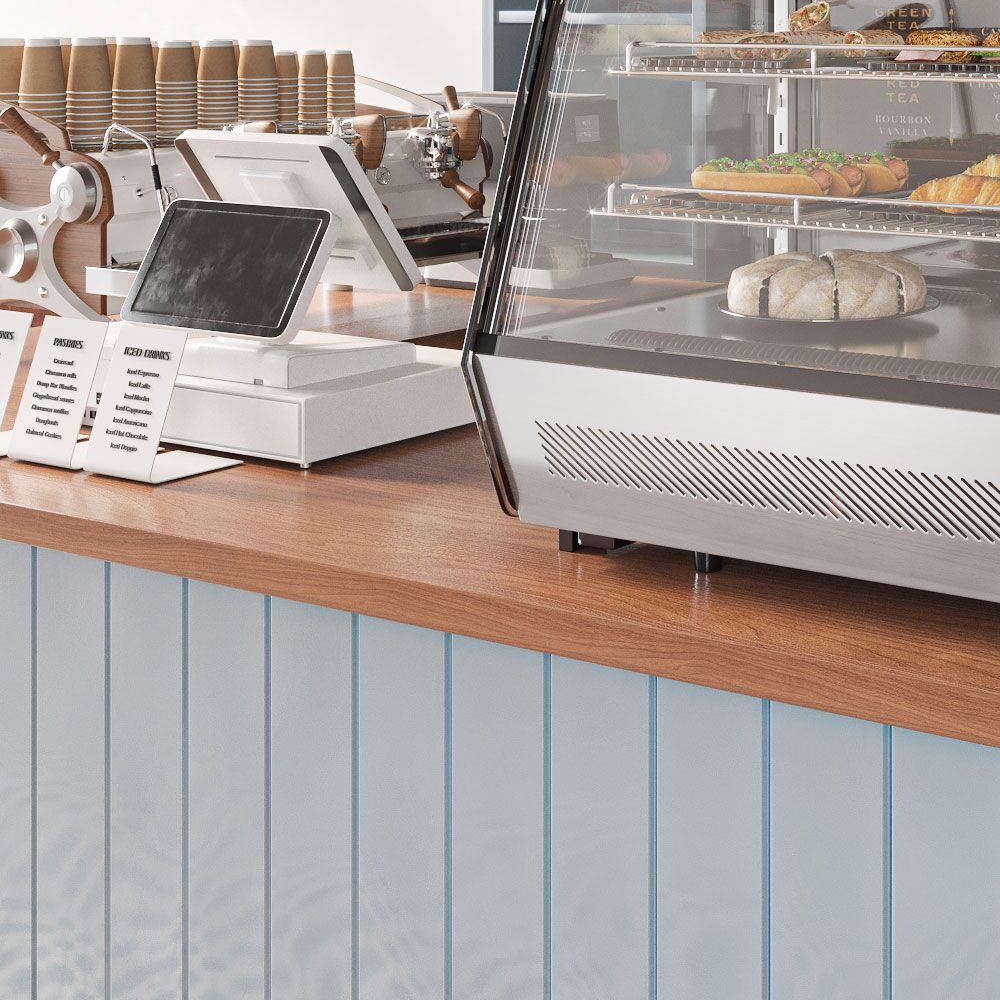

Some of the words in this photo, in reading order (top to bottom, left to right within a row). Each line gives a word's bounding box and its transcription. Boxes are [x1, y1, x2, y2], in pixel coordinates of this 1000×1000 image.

[874, 8, 932, 18] GREEN
[887, 21, 920, 30] TEA
[887, 93, 920, 104] TEA
[874, 114, 932, 125] BOURBON
[878, 127, 928, 138] VANILLA
[53, 337, 84, 349] PASTRIES
[124, 347, 142, 357] ICED
[144, 349, 171, 360] DRINKS
